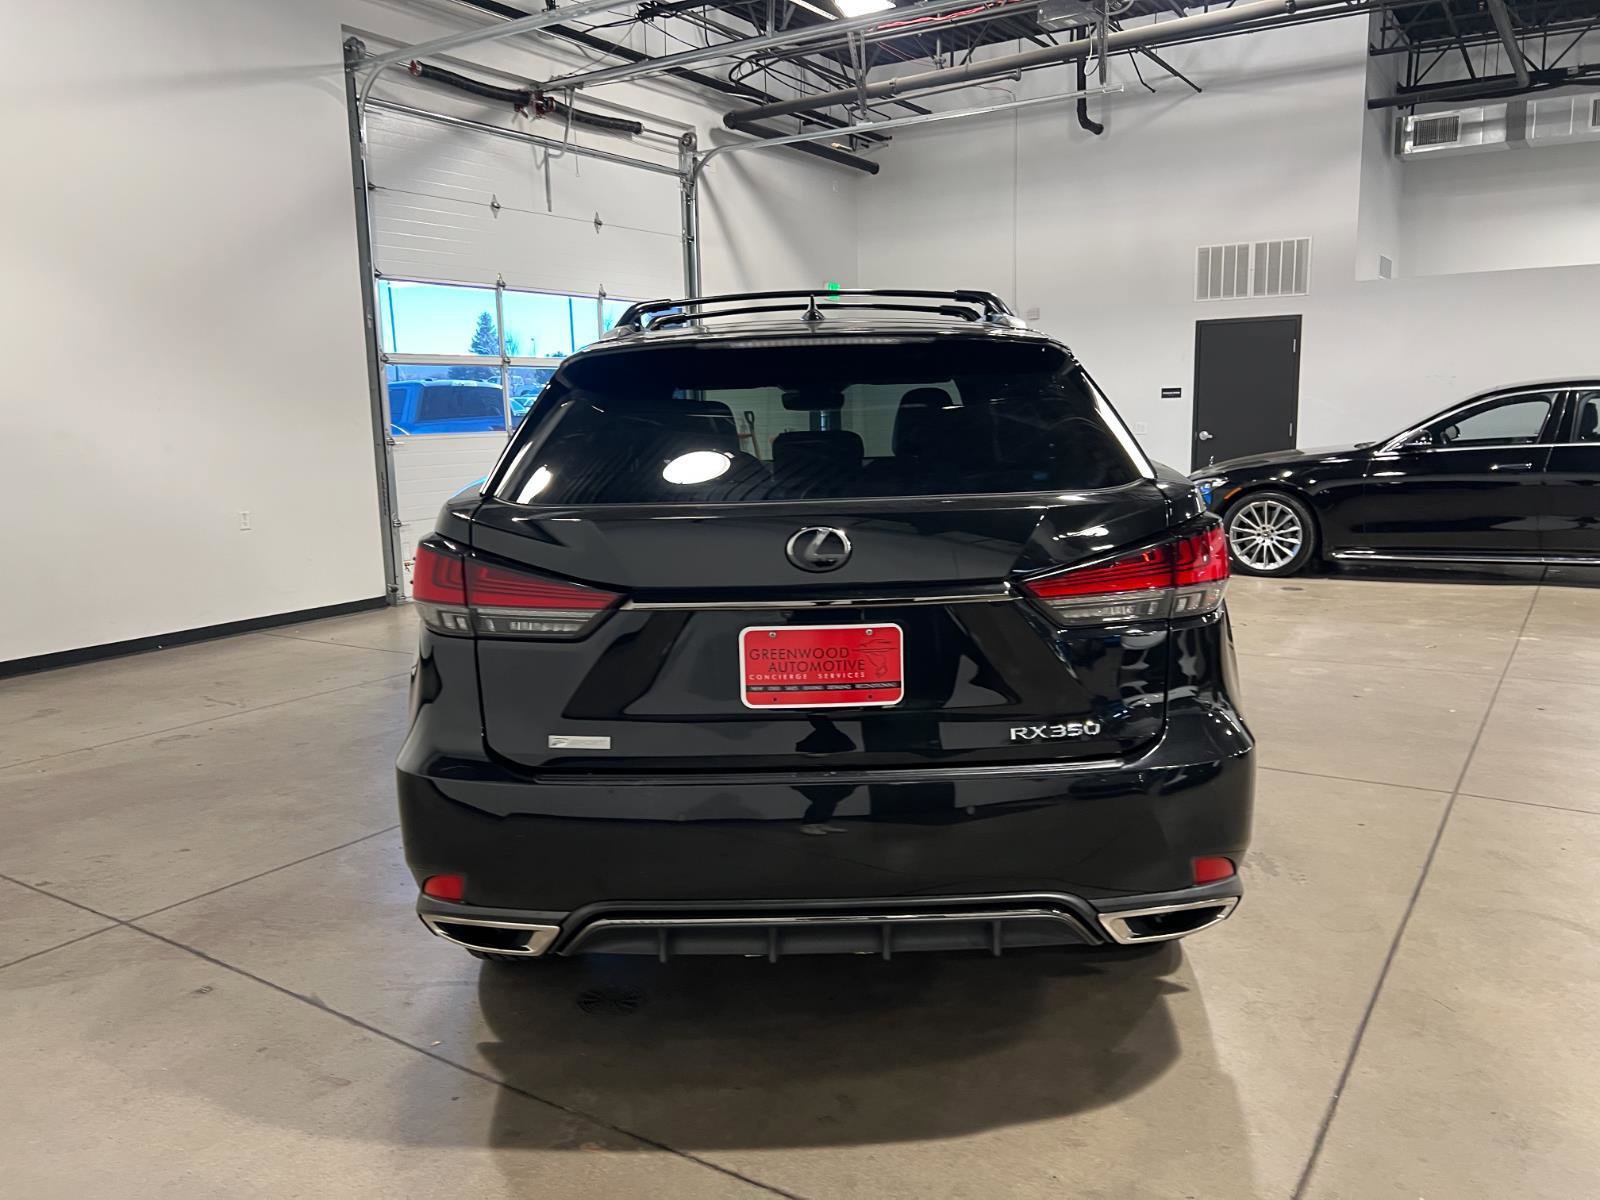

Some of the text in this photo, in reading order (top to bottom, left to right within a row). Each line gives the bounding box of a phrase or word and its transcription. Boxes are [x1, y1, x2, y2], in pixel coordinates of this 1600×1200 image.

[749, 647, 849, 661] GREENWOOD
[768, 659, 865, 673] AUTOMOTIVE
[817, 671, 865, 679] SERVICES
